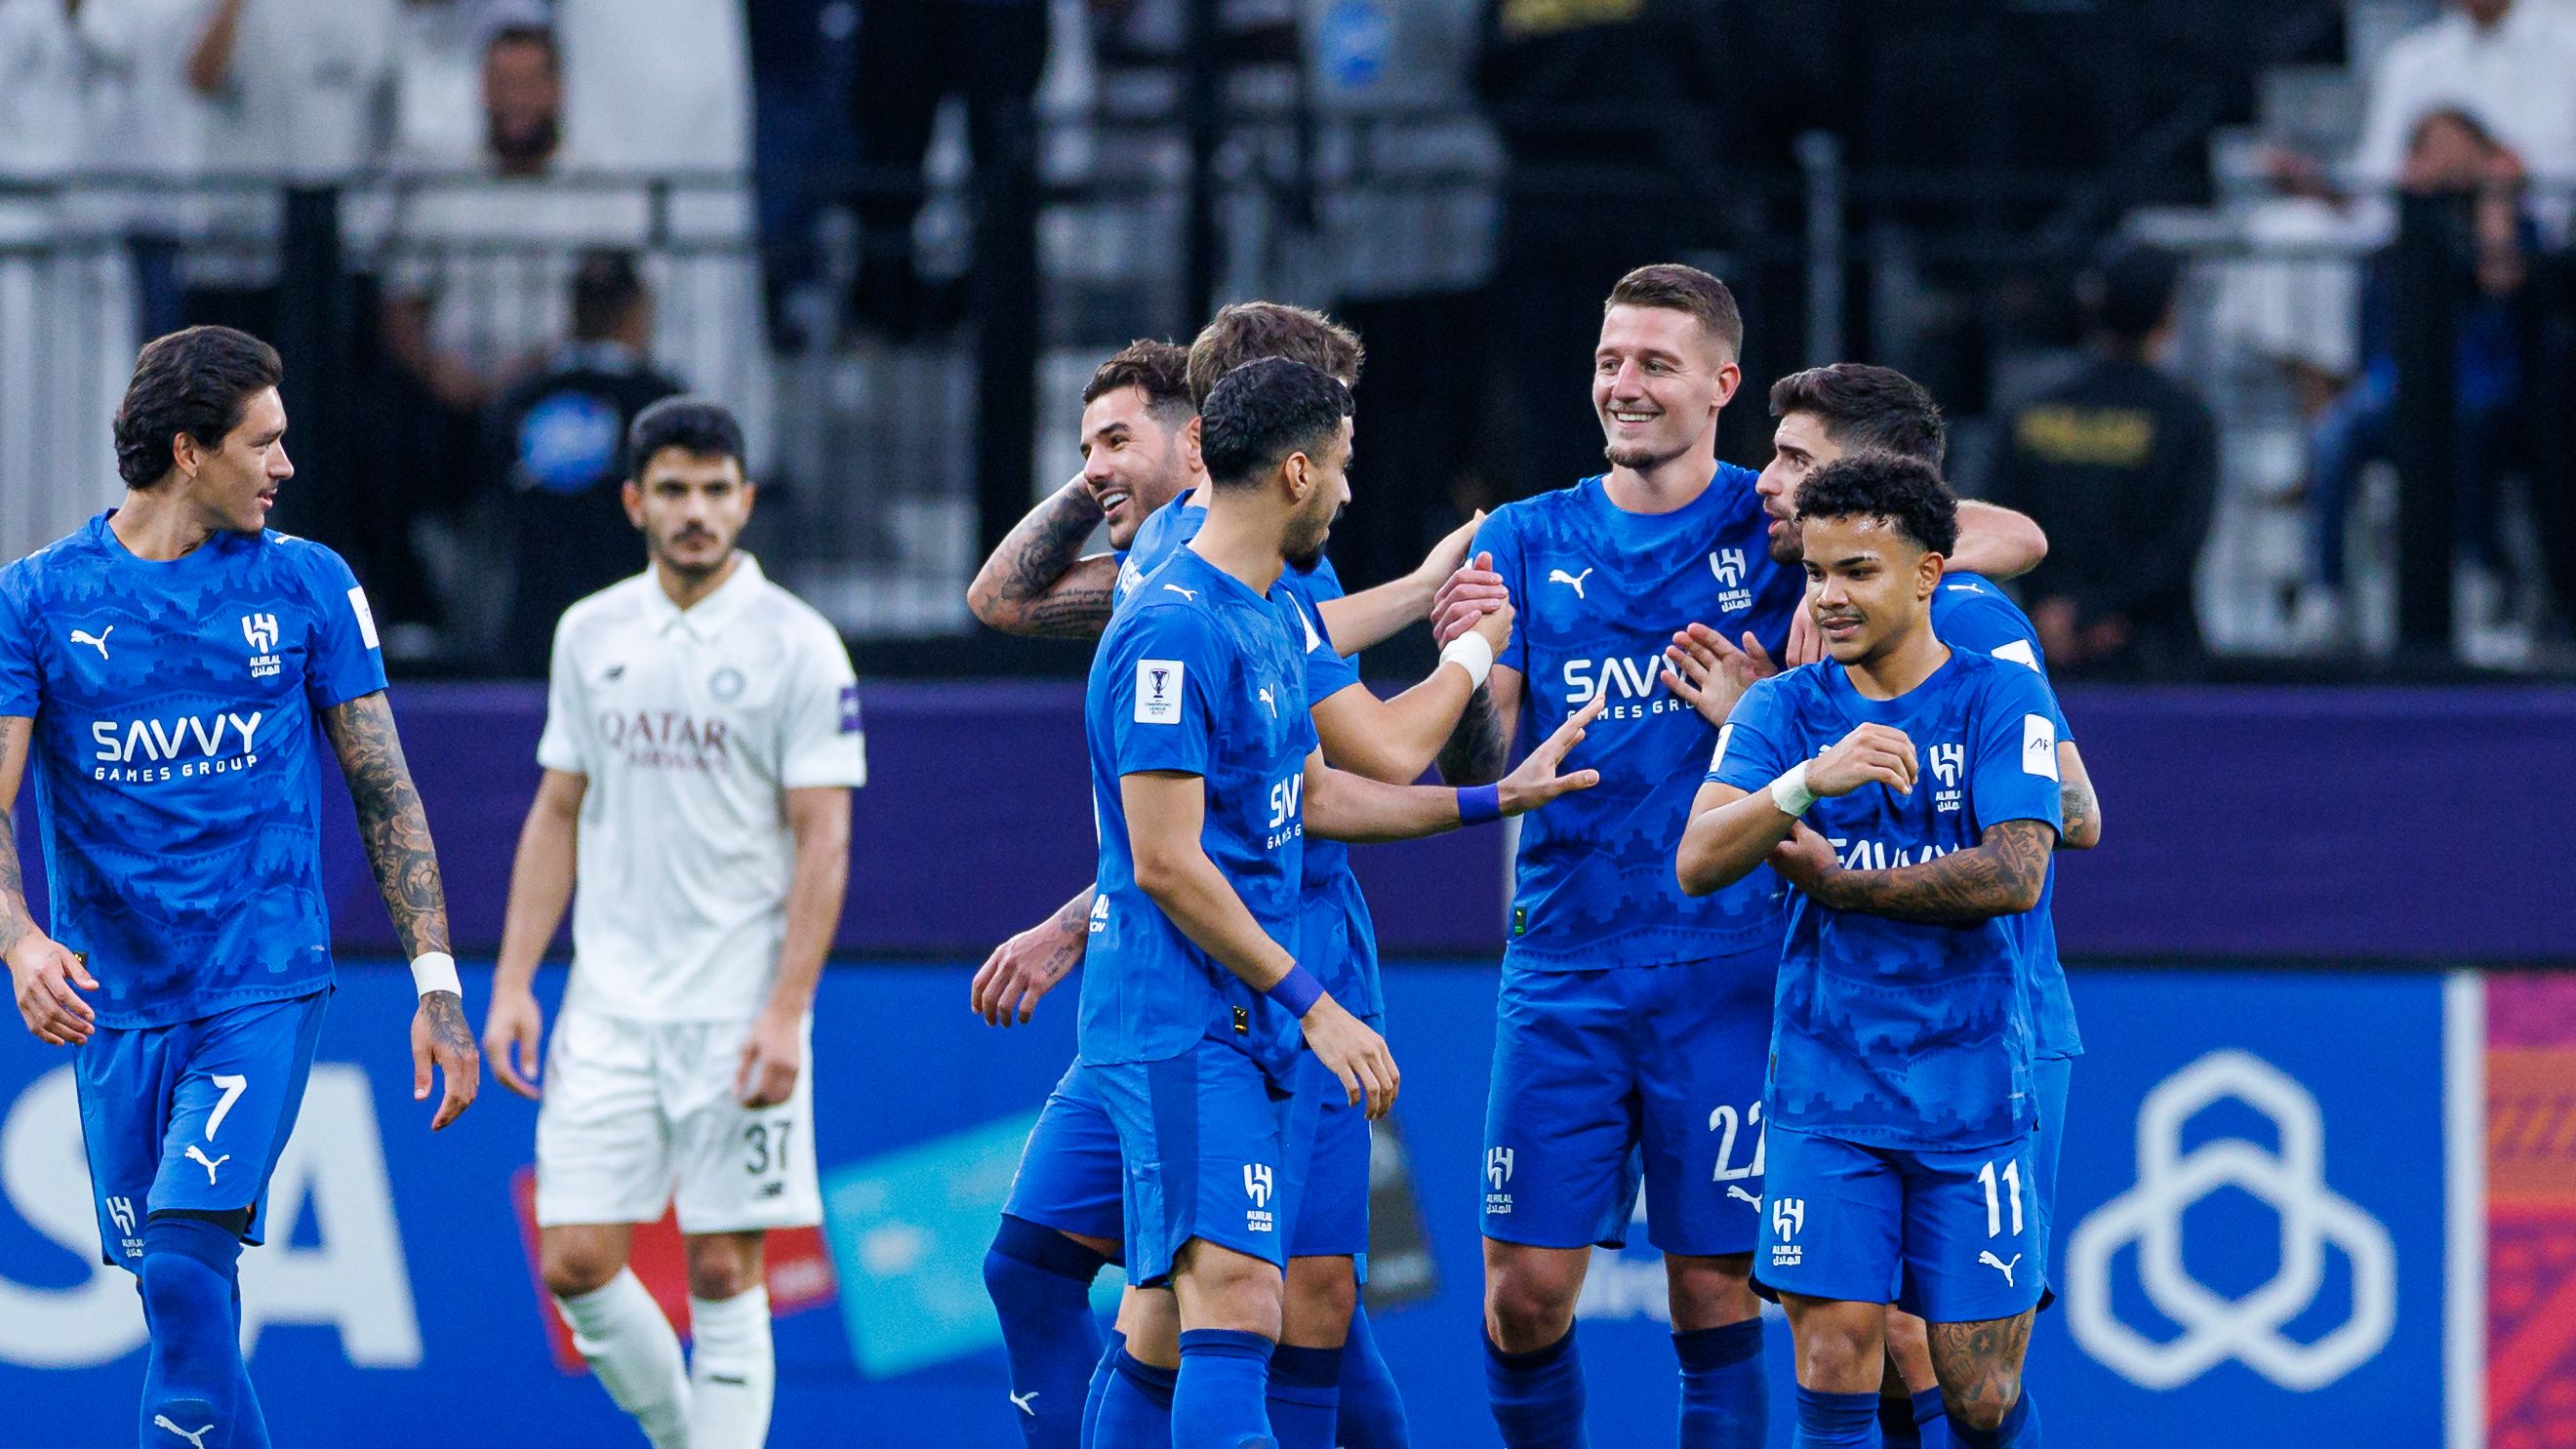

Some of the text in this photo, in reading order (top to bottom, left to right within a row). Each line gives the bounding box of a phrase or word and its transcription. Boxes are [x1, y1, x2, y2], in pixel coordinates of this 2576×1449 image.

[92, 711, 262, 762] SAVVY
[597, 709, 729, 755] QATAR
[95, 754, 258, 783] GAMES GROUP
[205, 1072, 248, 1143] 7
[745, 1119, 792, 1175] 37
[1977, 1157, 2024, 1239] 11
